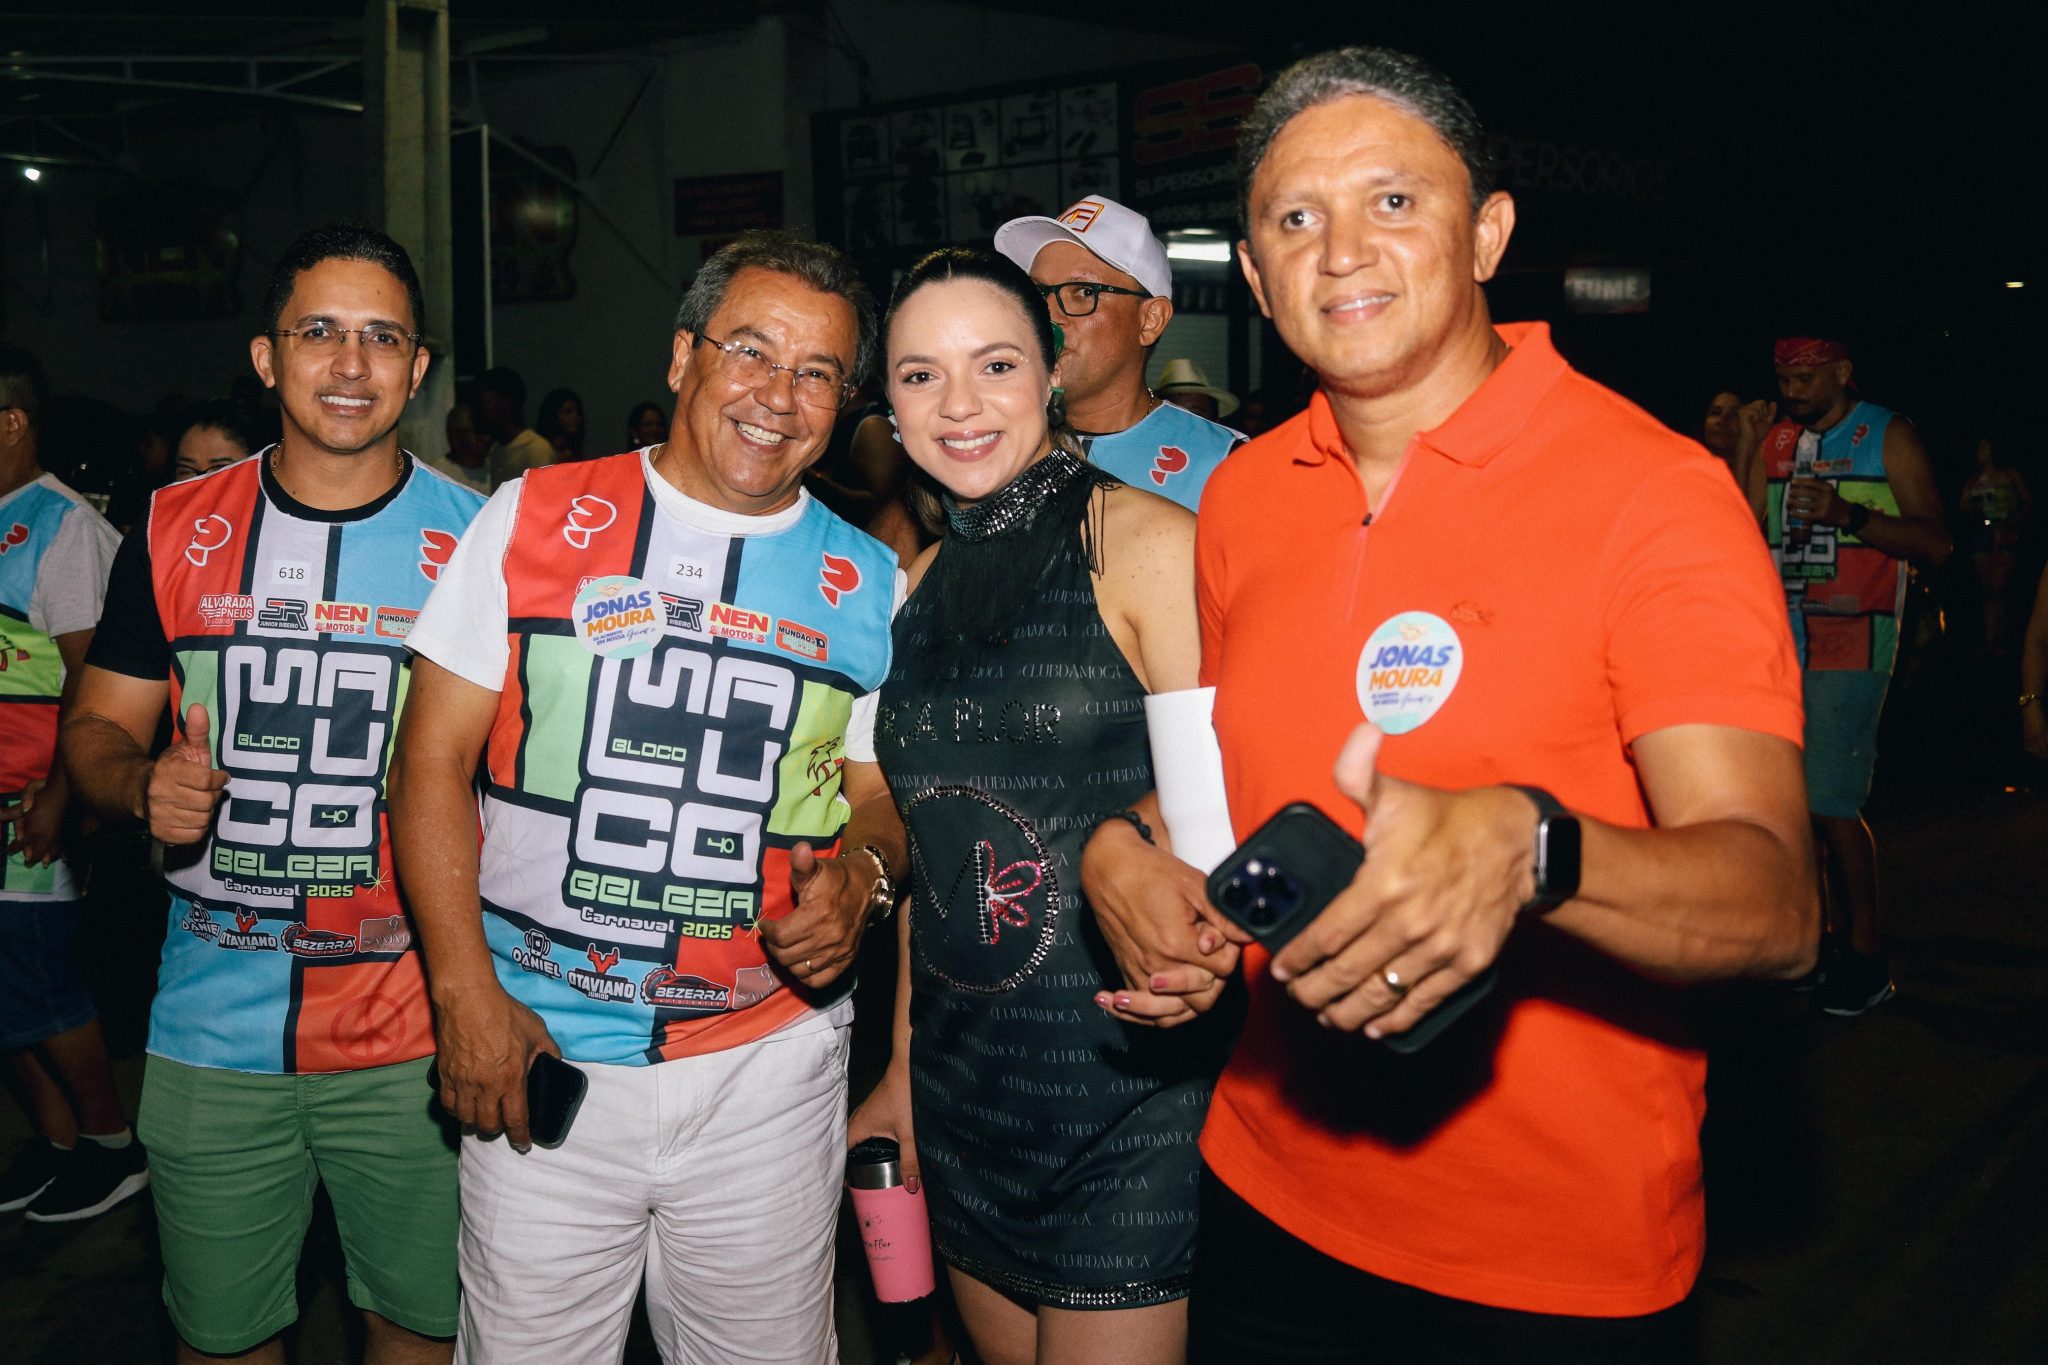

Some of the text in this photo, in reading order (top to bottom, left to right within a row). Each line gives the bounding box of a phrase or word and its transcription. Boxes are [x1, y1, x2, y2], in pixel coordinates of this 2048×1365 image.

[279, 566, 304, 580] 618
[676, 563, 703, 578] 234
[200, 595, 253, 609] ALVORADA
[582, 590, 652, 624] JONAS
[221, 607, 253, 619] PNEUS
[315, 603, 368, 622] NEN
[709, 604, 769, 633] NEN
[325, 622, 355, 632] MOTOS
[587, 607, 656, 638] MOURA
[664, 618, 692, 629] RIBEIRO
[720, 627, 754, 640] MOTOS
[1369, 645, 1455, 669] JONAS
[1368, 668, 1444, 691] MOURA
[955, 698, 1062, 745] FLOR
[238, 733, 300, 750] BLOCO
[611, 738, 688, 763] BLOCO
[224, 877, 354, 898] Carnaval 2025
[580, 906, 733, 940] Carnaval 2025
[219, 931, 278, 947] OTAVIANO
[293, 938, 354, 951] BEZERRA
[512, 948, 561, 978] DANIEL
[568, 970, 635, 999] OTAVIANO
[654, 986, 728, 1001] BEZERRA
[587, 991, 609, 1001] JUNIOR
[1111, 1129, 1198, 1153] CLUBDAMOC
[1112, 1208, 1198, 1228] CLUBDAMOC
